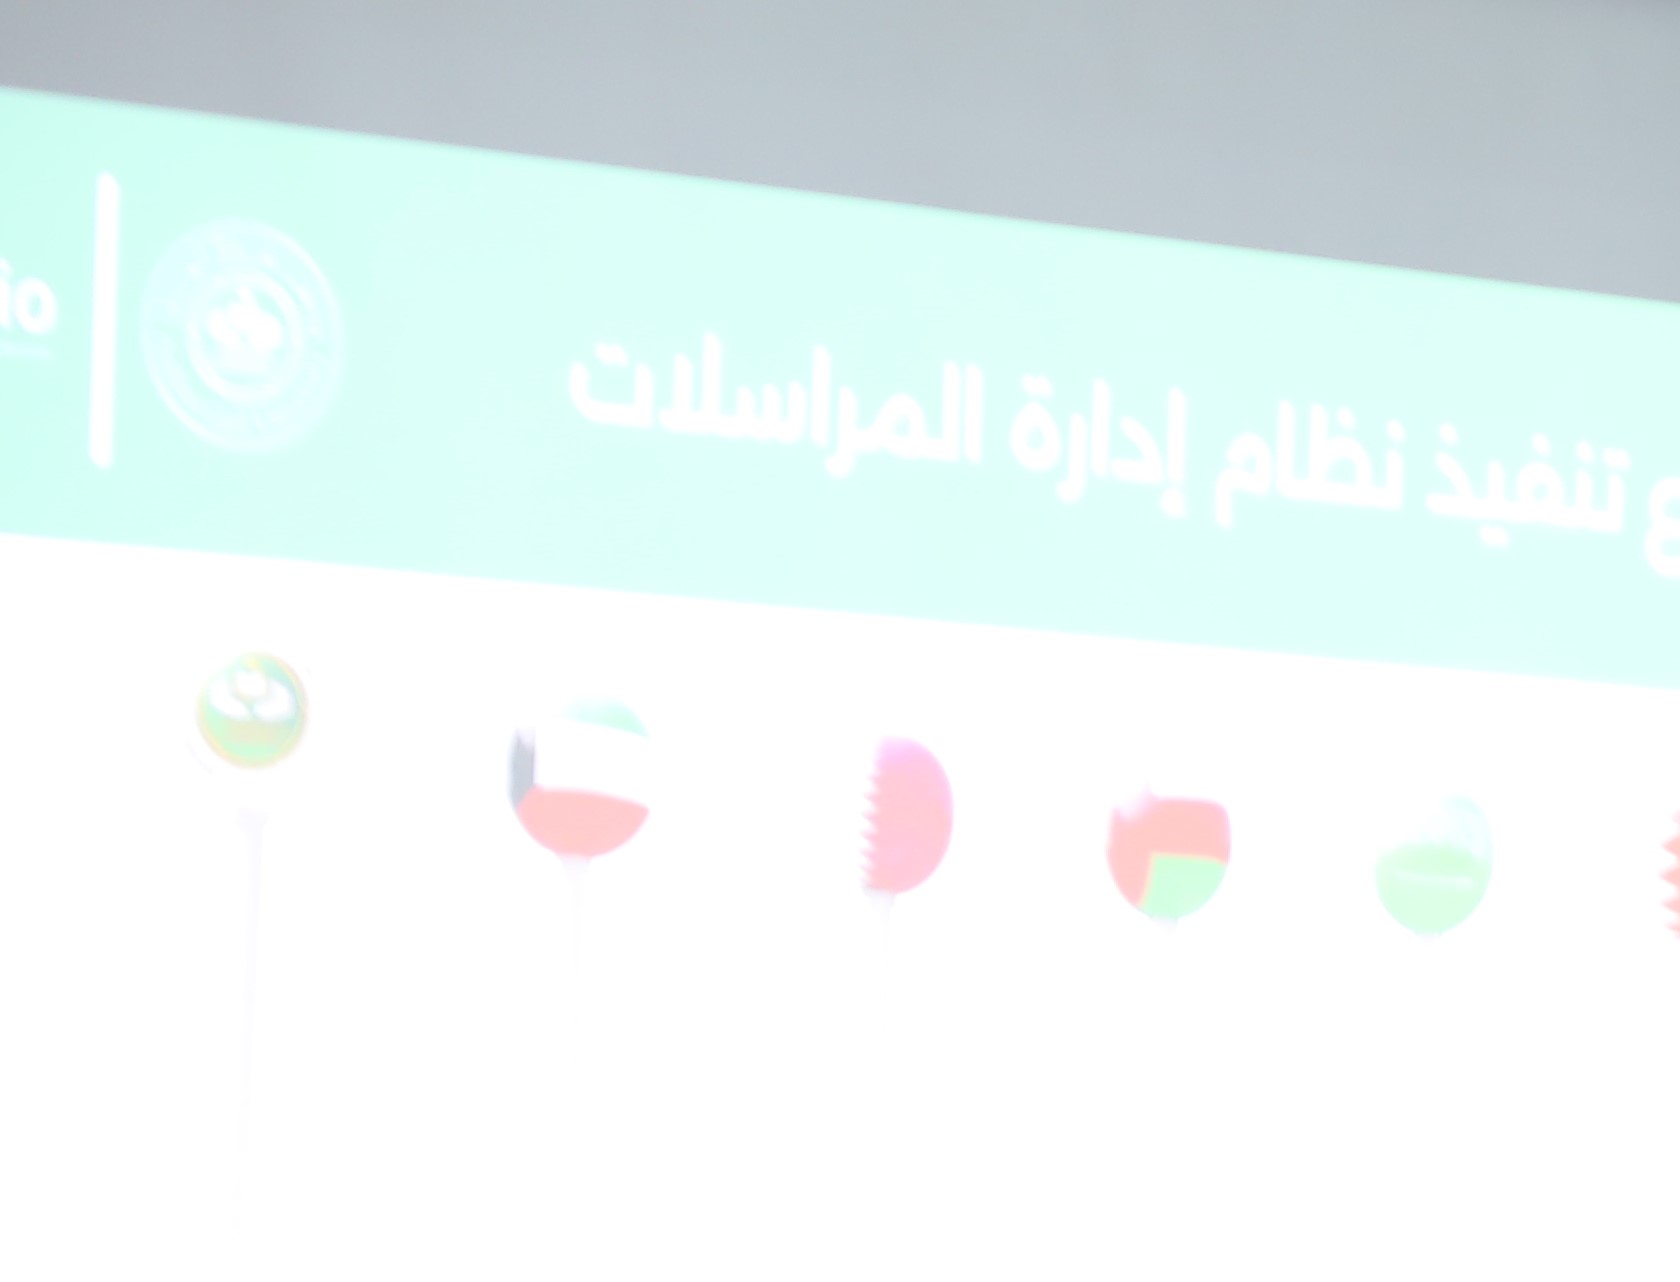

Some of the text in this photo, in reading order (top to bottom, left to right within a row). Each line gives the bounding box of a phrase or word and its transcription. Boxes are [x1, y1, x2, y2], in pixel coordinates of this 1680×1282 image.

[568, 329, 984, 479] المراسلات
[1009, 374, 1188, 520] إدارة
[1213, 399, 1405, 529] نظام
[1425, 422, 1633, 548] تنفيذ
